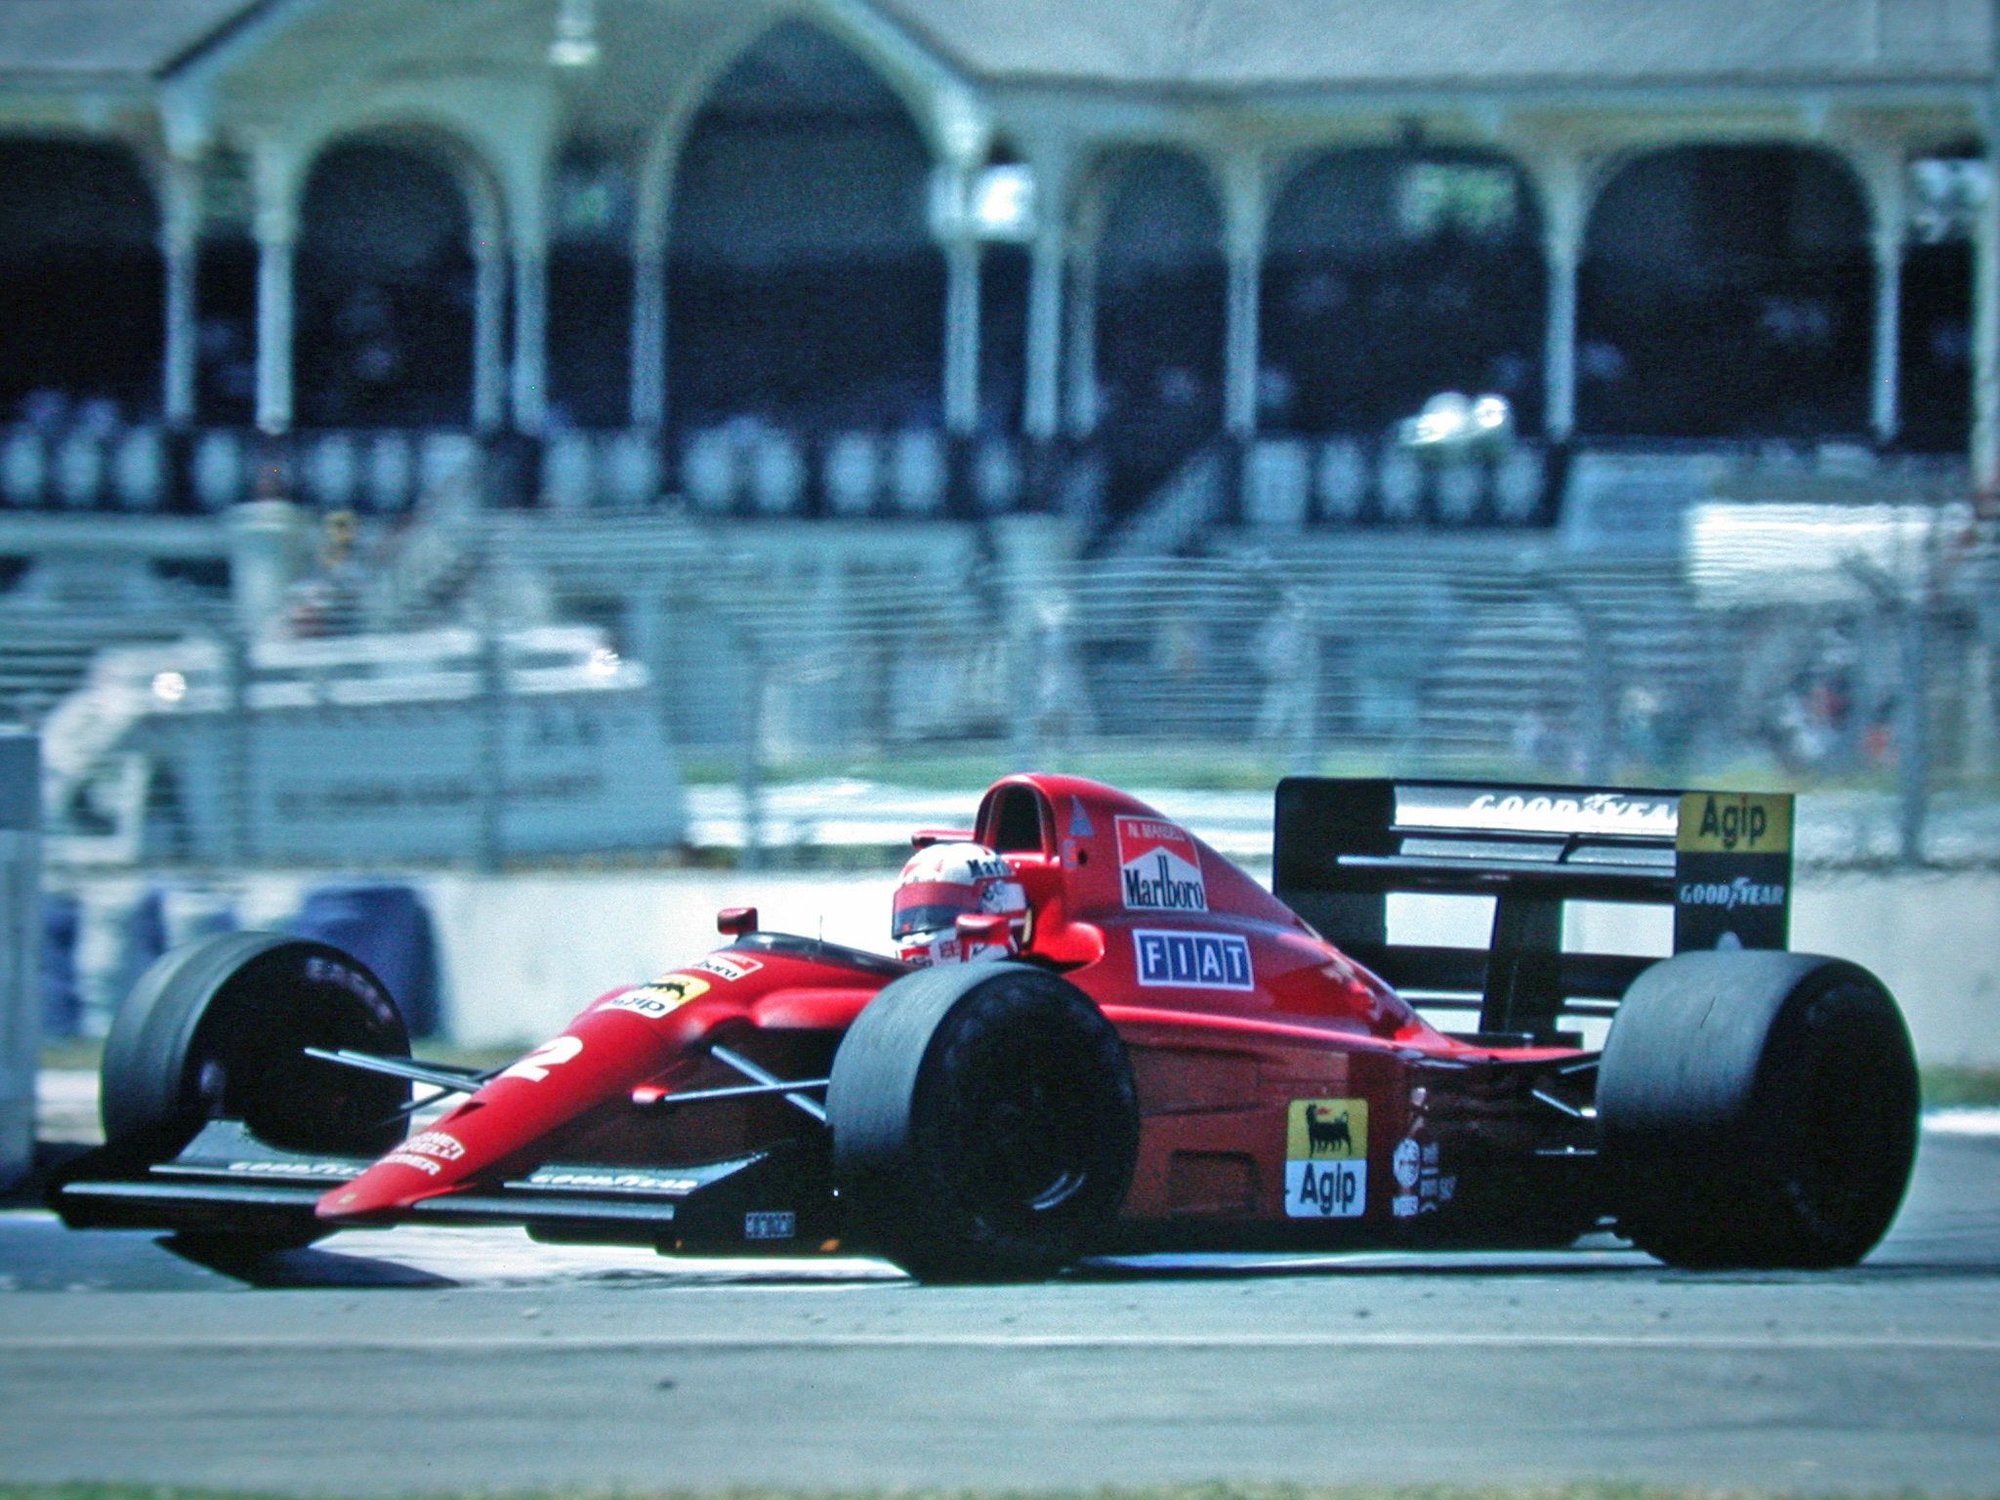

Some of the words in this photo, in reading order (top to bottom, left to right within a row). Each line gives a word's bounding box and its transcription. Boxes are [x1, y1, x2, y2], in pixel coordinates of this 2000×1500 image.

[1699, 798, 1766, 849] Agip
[1123, 855, 1205, 910] Marlboro
[1680, 877, 1784, 910] GOODYEAR
[1143, 939, 1247, 980] FIAT
[499, 1036, 583, 1082] 2
[1300, 1161, 1356, 1216] Agip
